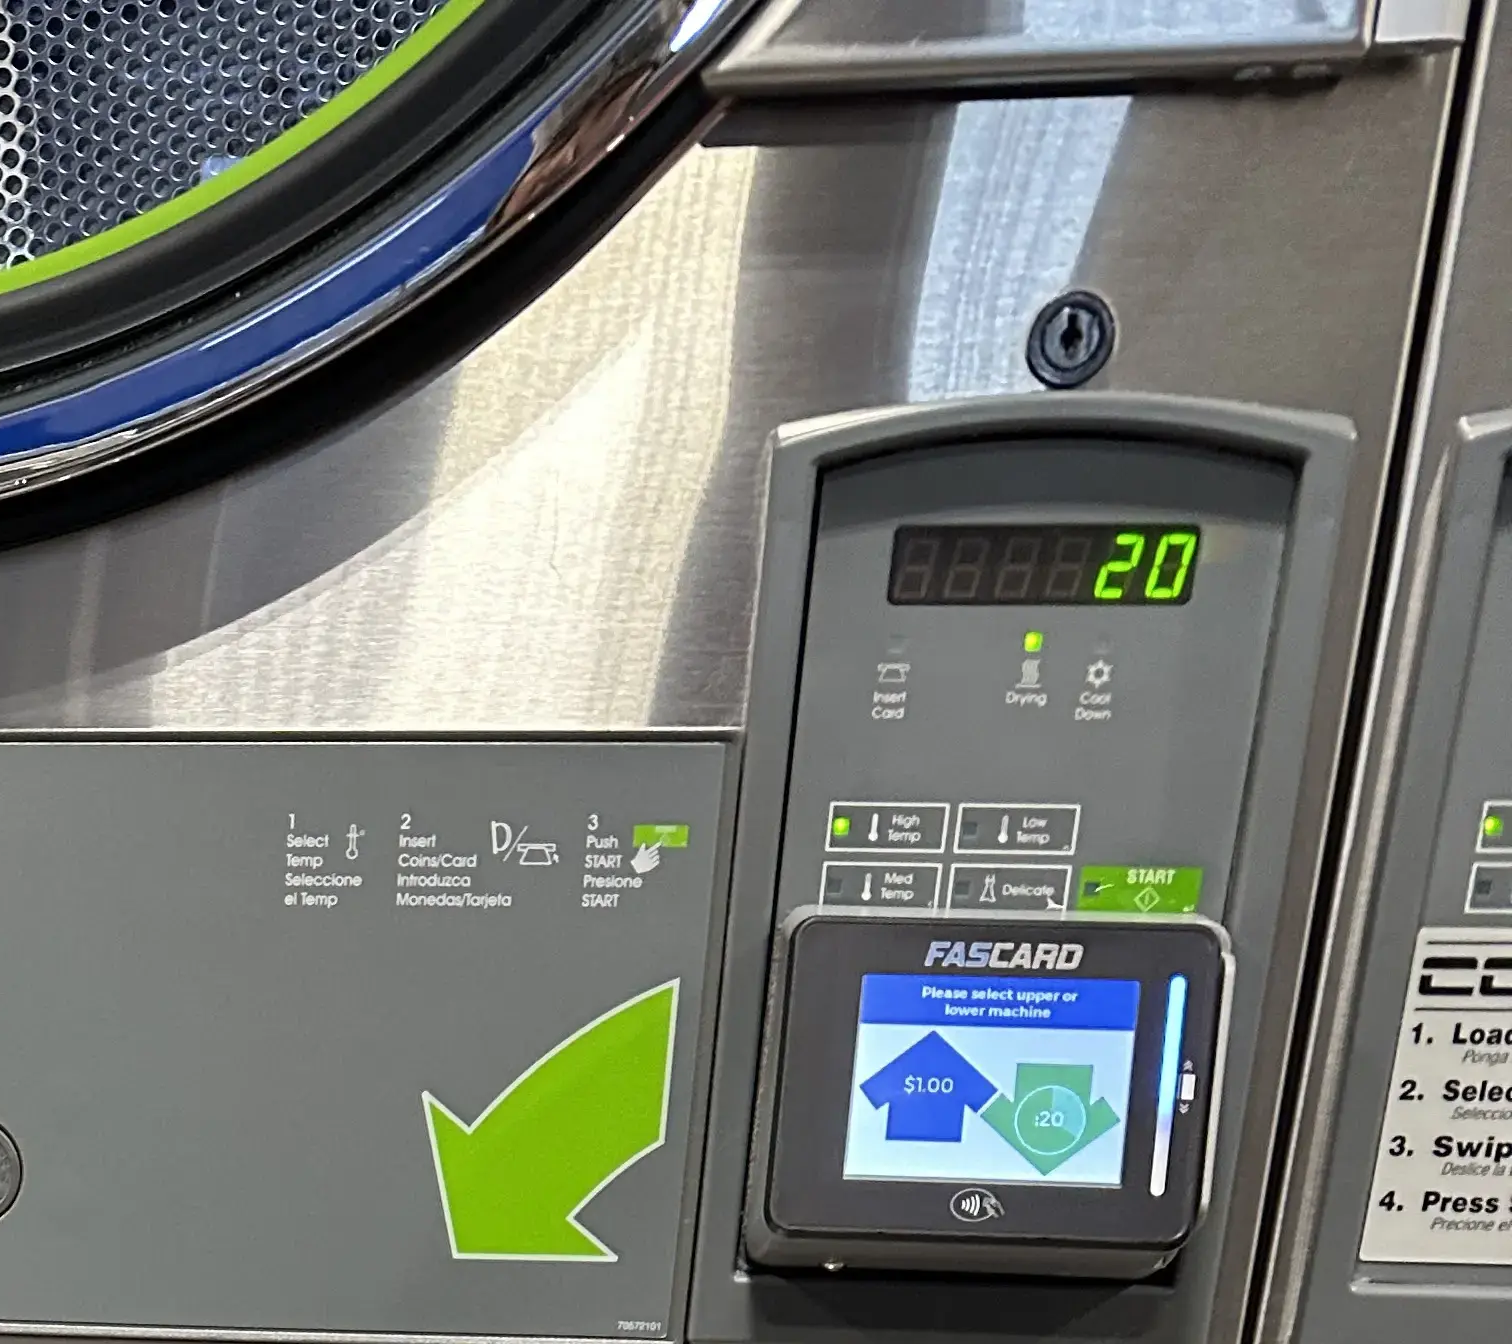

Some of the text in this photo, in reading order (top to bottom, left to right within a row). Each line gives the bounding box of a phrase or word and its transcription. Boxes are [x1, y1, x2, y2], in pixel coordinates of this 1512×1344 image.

[1094, 533, 1197, 599] 20
[1005, 691, 1048, 707] Drying
[1079, 691, 1112, 704] Cool
[872, 706, 905, 720] Card
[1075, 706, 1112, 720] Down
[287, 813, 296, 830] 1
[400, 813, 412, 831] 2
[587, 813, 599, 831] 3
[891, 814, 921, 828] High
[1021, 816, 1048, 828] Low
[286, 833, 329, 848] Select
[399, 833, 437, 848] Insert
[586, 833, 619, 848] Push
[888, 829, 921, 844] Temp
[1017, 830, 1050, 845] Temp
[286, 853, 324, 870] Temp
[398, 852, 477, 869] Coins/Card
[584, 854, 623, 869] START
[285, 873, 362, 888] Seleccione
[396, 873, 471, 888] Introduzca
[582, 874, 643, 889] Presione
[884, 872, 914, 886] Med
[1127, 870, 1175, 884] START
[881, 887, 914, 901] Temp
[1002, 883, 1055, 898] Delicate
[284, 892, 338, 909] el Temp
[396, 892, 512, 910] Monedas/Tarjeta
[581, 893, 619, 908] START
[924, 941, 1084, 971] FASCARD
[922, 986, 1078, 1005] Please select upper or
[944, 1003, 1051, 1019] lower machine
[1412, 1022, 1433, 1044] 1.
[903, 1076, 953, 1094] $1.00
[1399, 1079, 1424, 1101] 2.
[1389, 1135, 1512, 1163] 3. Swip
[1379, 1190, 1403, 1212] 4.
[1421, 1190, 1499, 1213] Press
